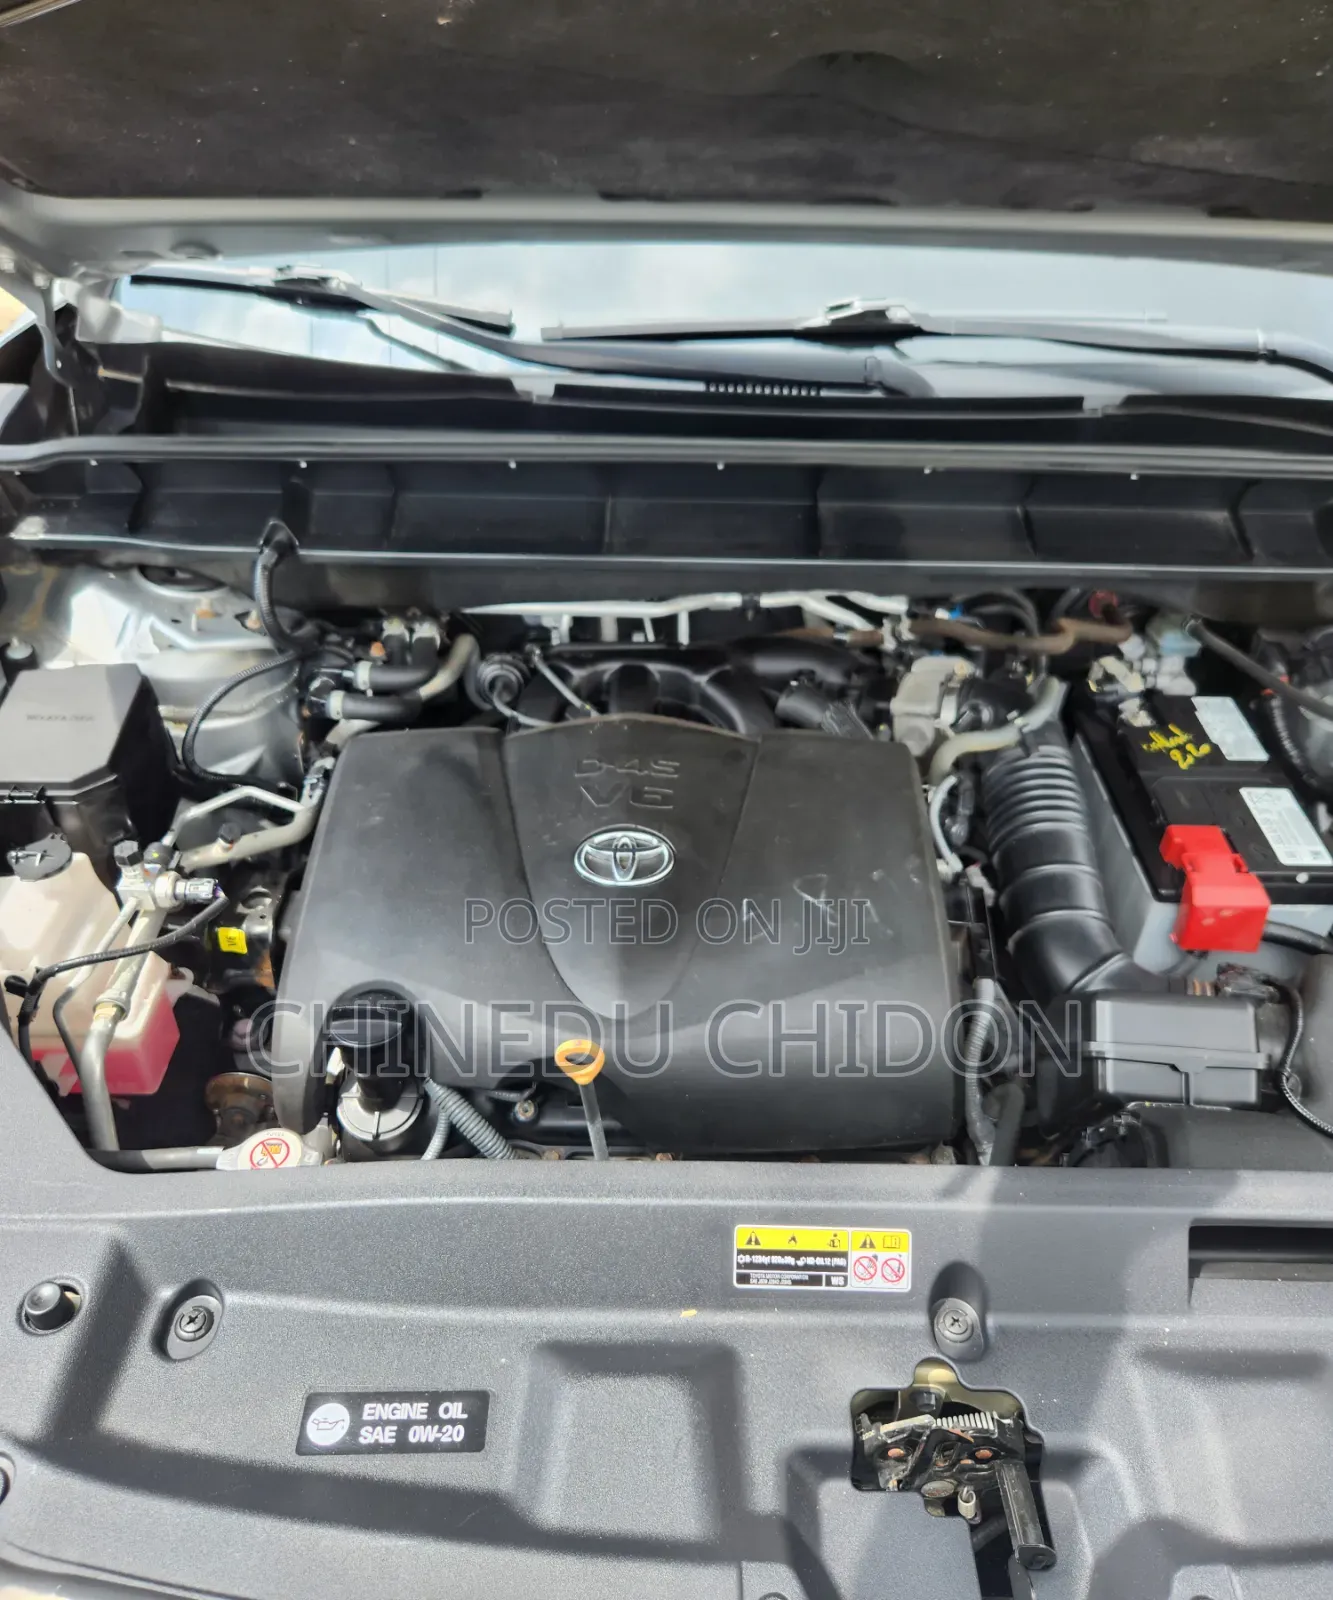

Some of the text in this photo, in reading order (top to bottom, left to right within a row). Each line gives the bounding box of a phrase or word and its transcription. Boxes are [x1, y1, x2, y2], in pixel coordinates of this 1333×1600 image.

[831, 1276, 845, 1286] WS
[362, 1401, 468, 1421] ENGINE OIL
[358, 1424, 466, 1444] SAE 0W-20
